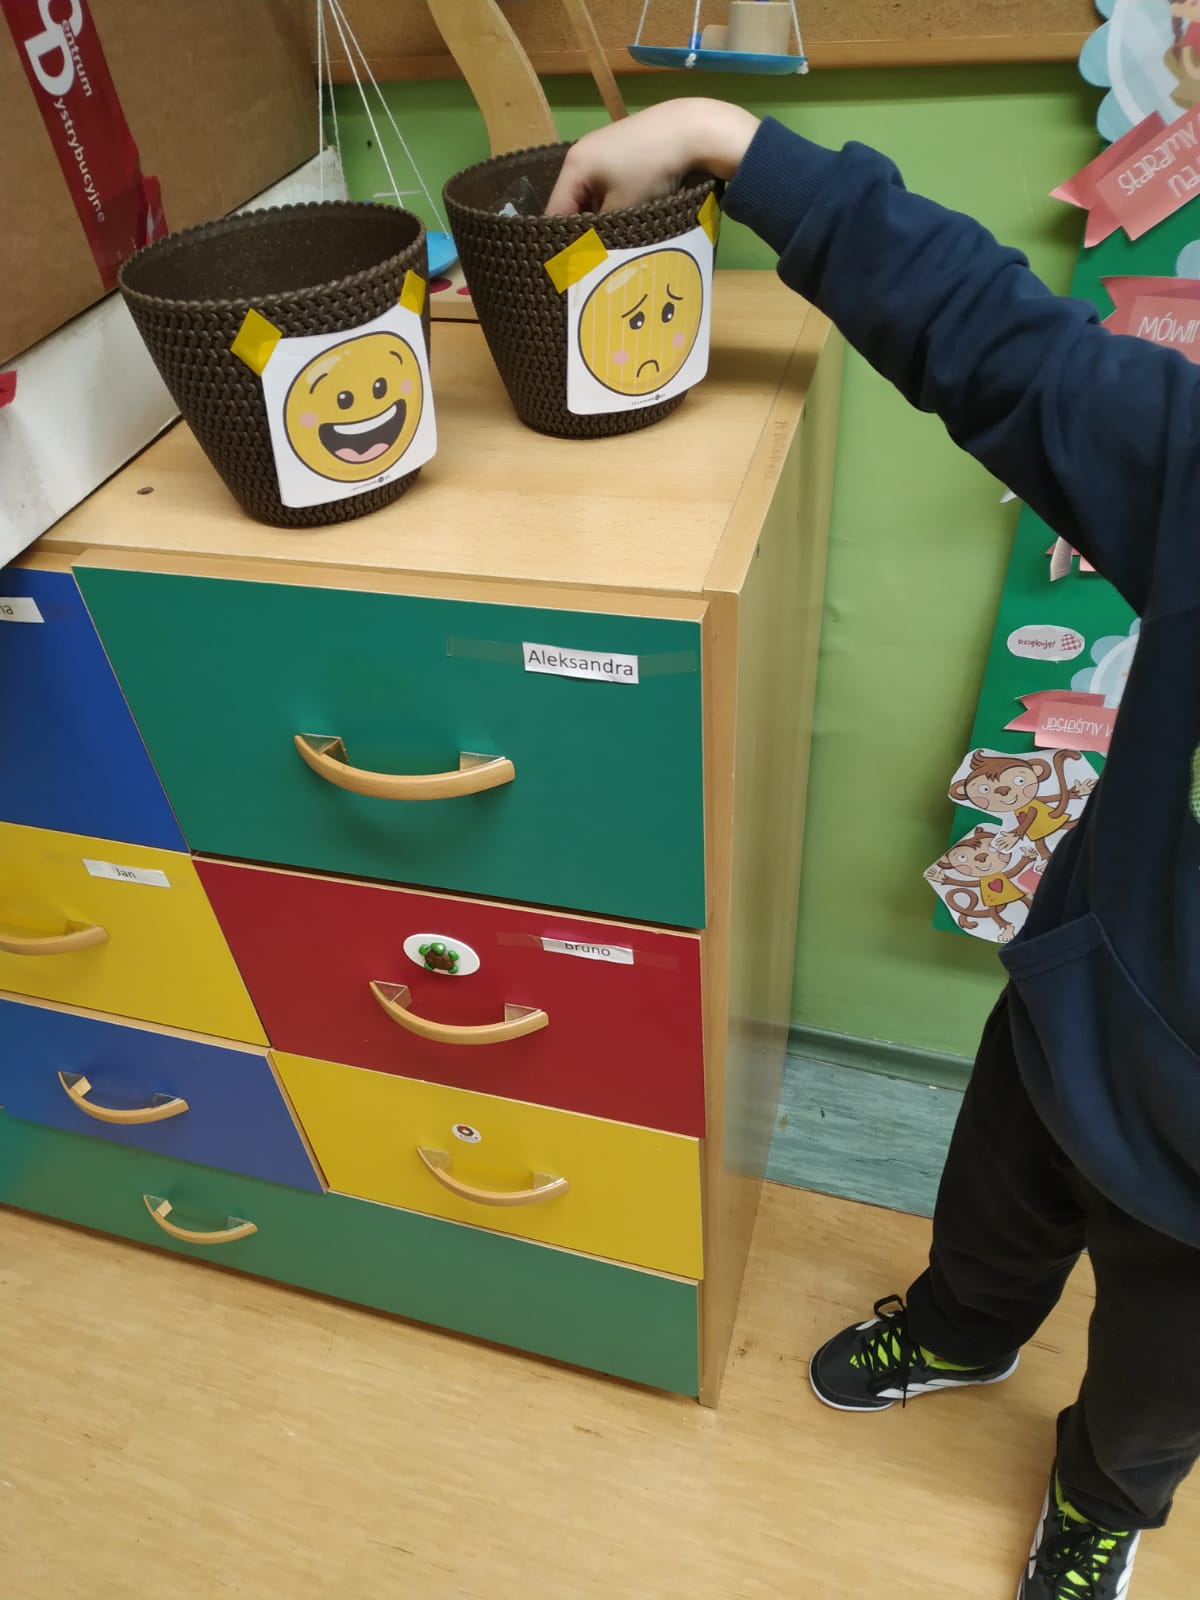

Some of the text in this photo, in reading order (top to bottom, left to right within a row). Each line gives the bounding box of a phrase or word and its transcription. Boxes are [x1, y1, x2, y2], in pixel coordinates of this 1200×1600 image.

[528, 649, 634, 677] Aleksandra
[112, 864, 137, 879] Jan
[564, 942, 611, 957] Bruno
